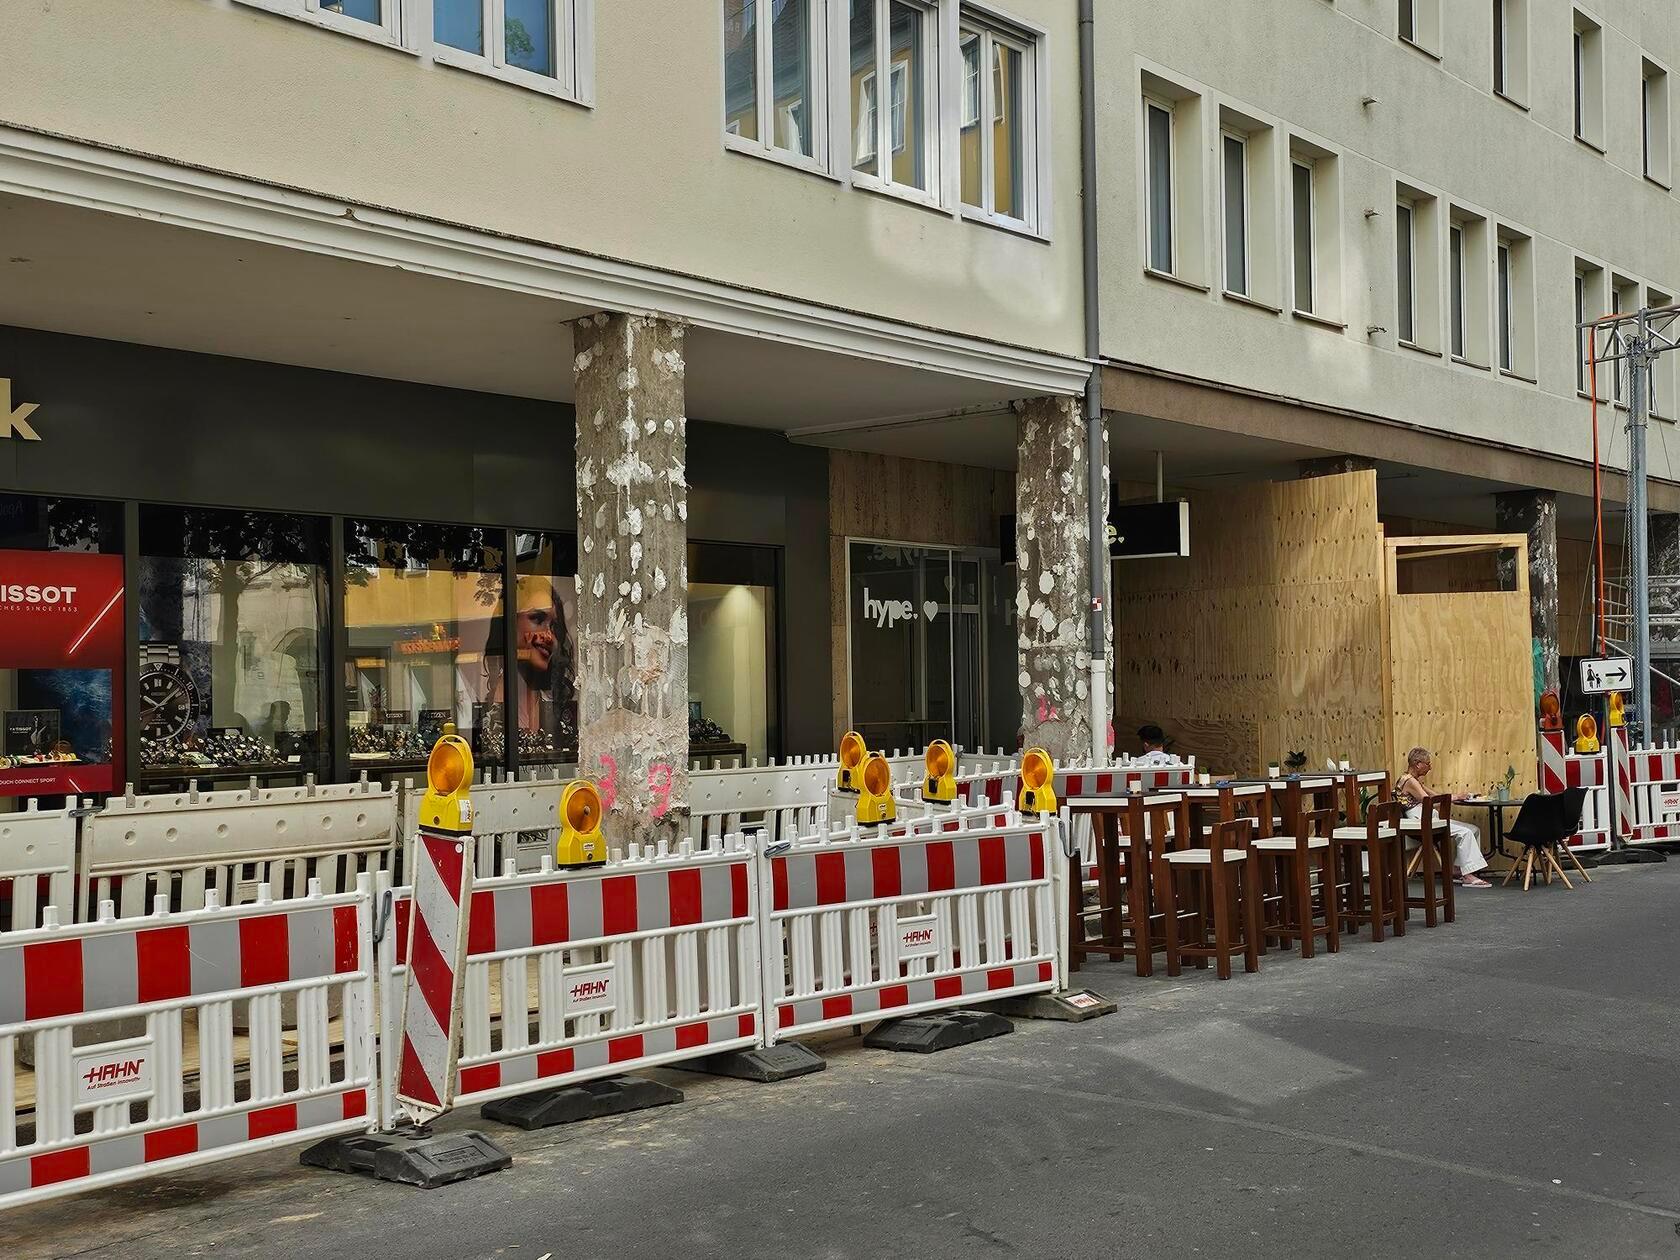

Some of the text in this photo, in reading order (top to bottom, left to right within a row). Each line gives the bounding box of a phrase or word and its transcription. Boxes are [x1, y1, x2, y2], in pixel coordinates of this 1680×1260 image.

[0, 585, 77, 604] ISSOT
[903, 929, 933, 943] HAHN
[570, 979, 609, 997] HAHN
[82, 1059, 145, 1084] HAHN
